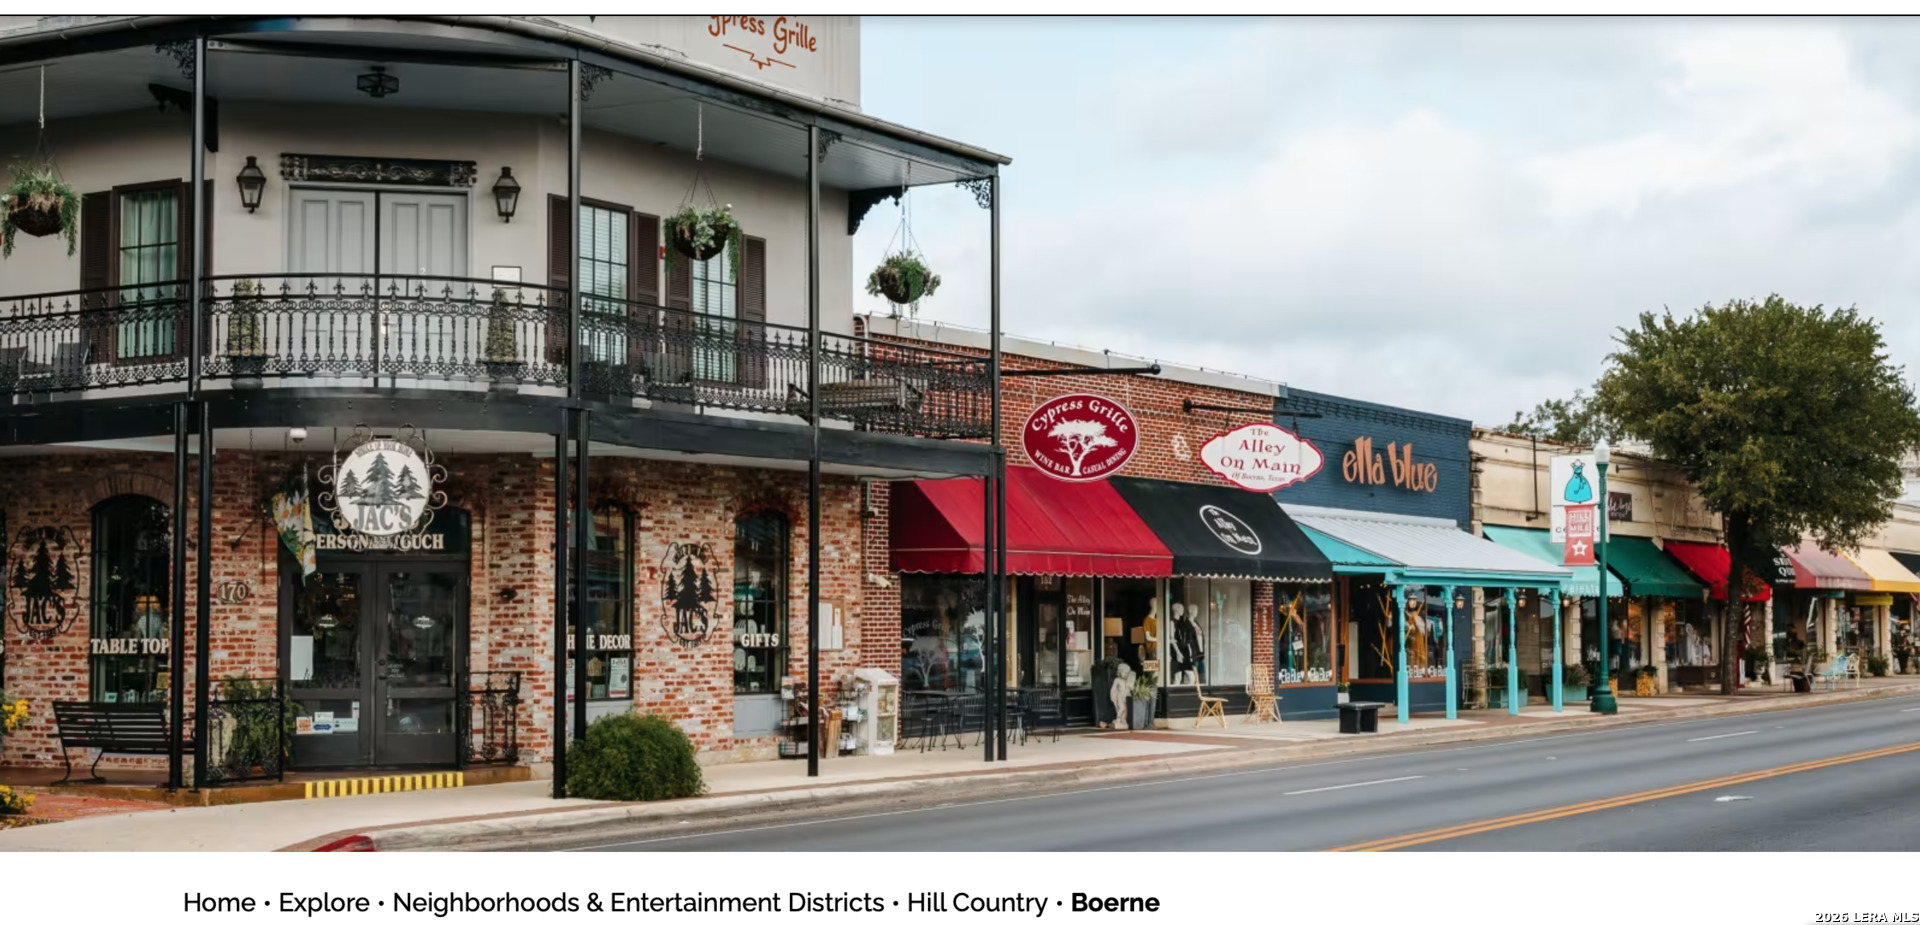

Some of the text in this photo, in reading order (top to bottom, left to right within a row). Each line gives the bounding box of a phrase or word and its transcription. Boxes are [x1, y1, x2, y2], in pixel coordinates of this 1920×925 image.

[708, 15, 817, 54] ypress Grille
[1032, 400, 1128, 433] Cypress Grille
[1250, 428, 1269, 436] The
[1239, 439, 1286, 456] Alley
[1034, 449, 1071, 474] WINE BAR
[1082, 447, 1127, 475] CASUAL DINING
[1220, 456, 1302, 475] On Main
[1342, 436, 1438, 492] ella blue
[353, 504, 412, 531] JAC'S
[316, 534, 391, 549] ERSON
[219, 583, 246, 604] 170
[22, 596, 66, 625] JAC'S
[673, 606, 709, 635] JAC'S
[91, 638, 169, 654] TABLE TOP
[567, 634, 632, 650] HE DECOR
[741, 633, 780, 648] GIFTS
